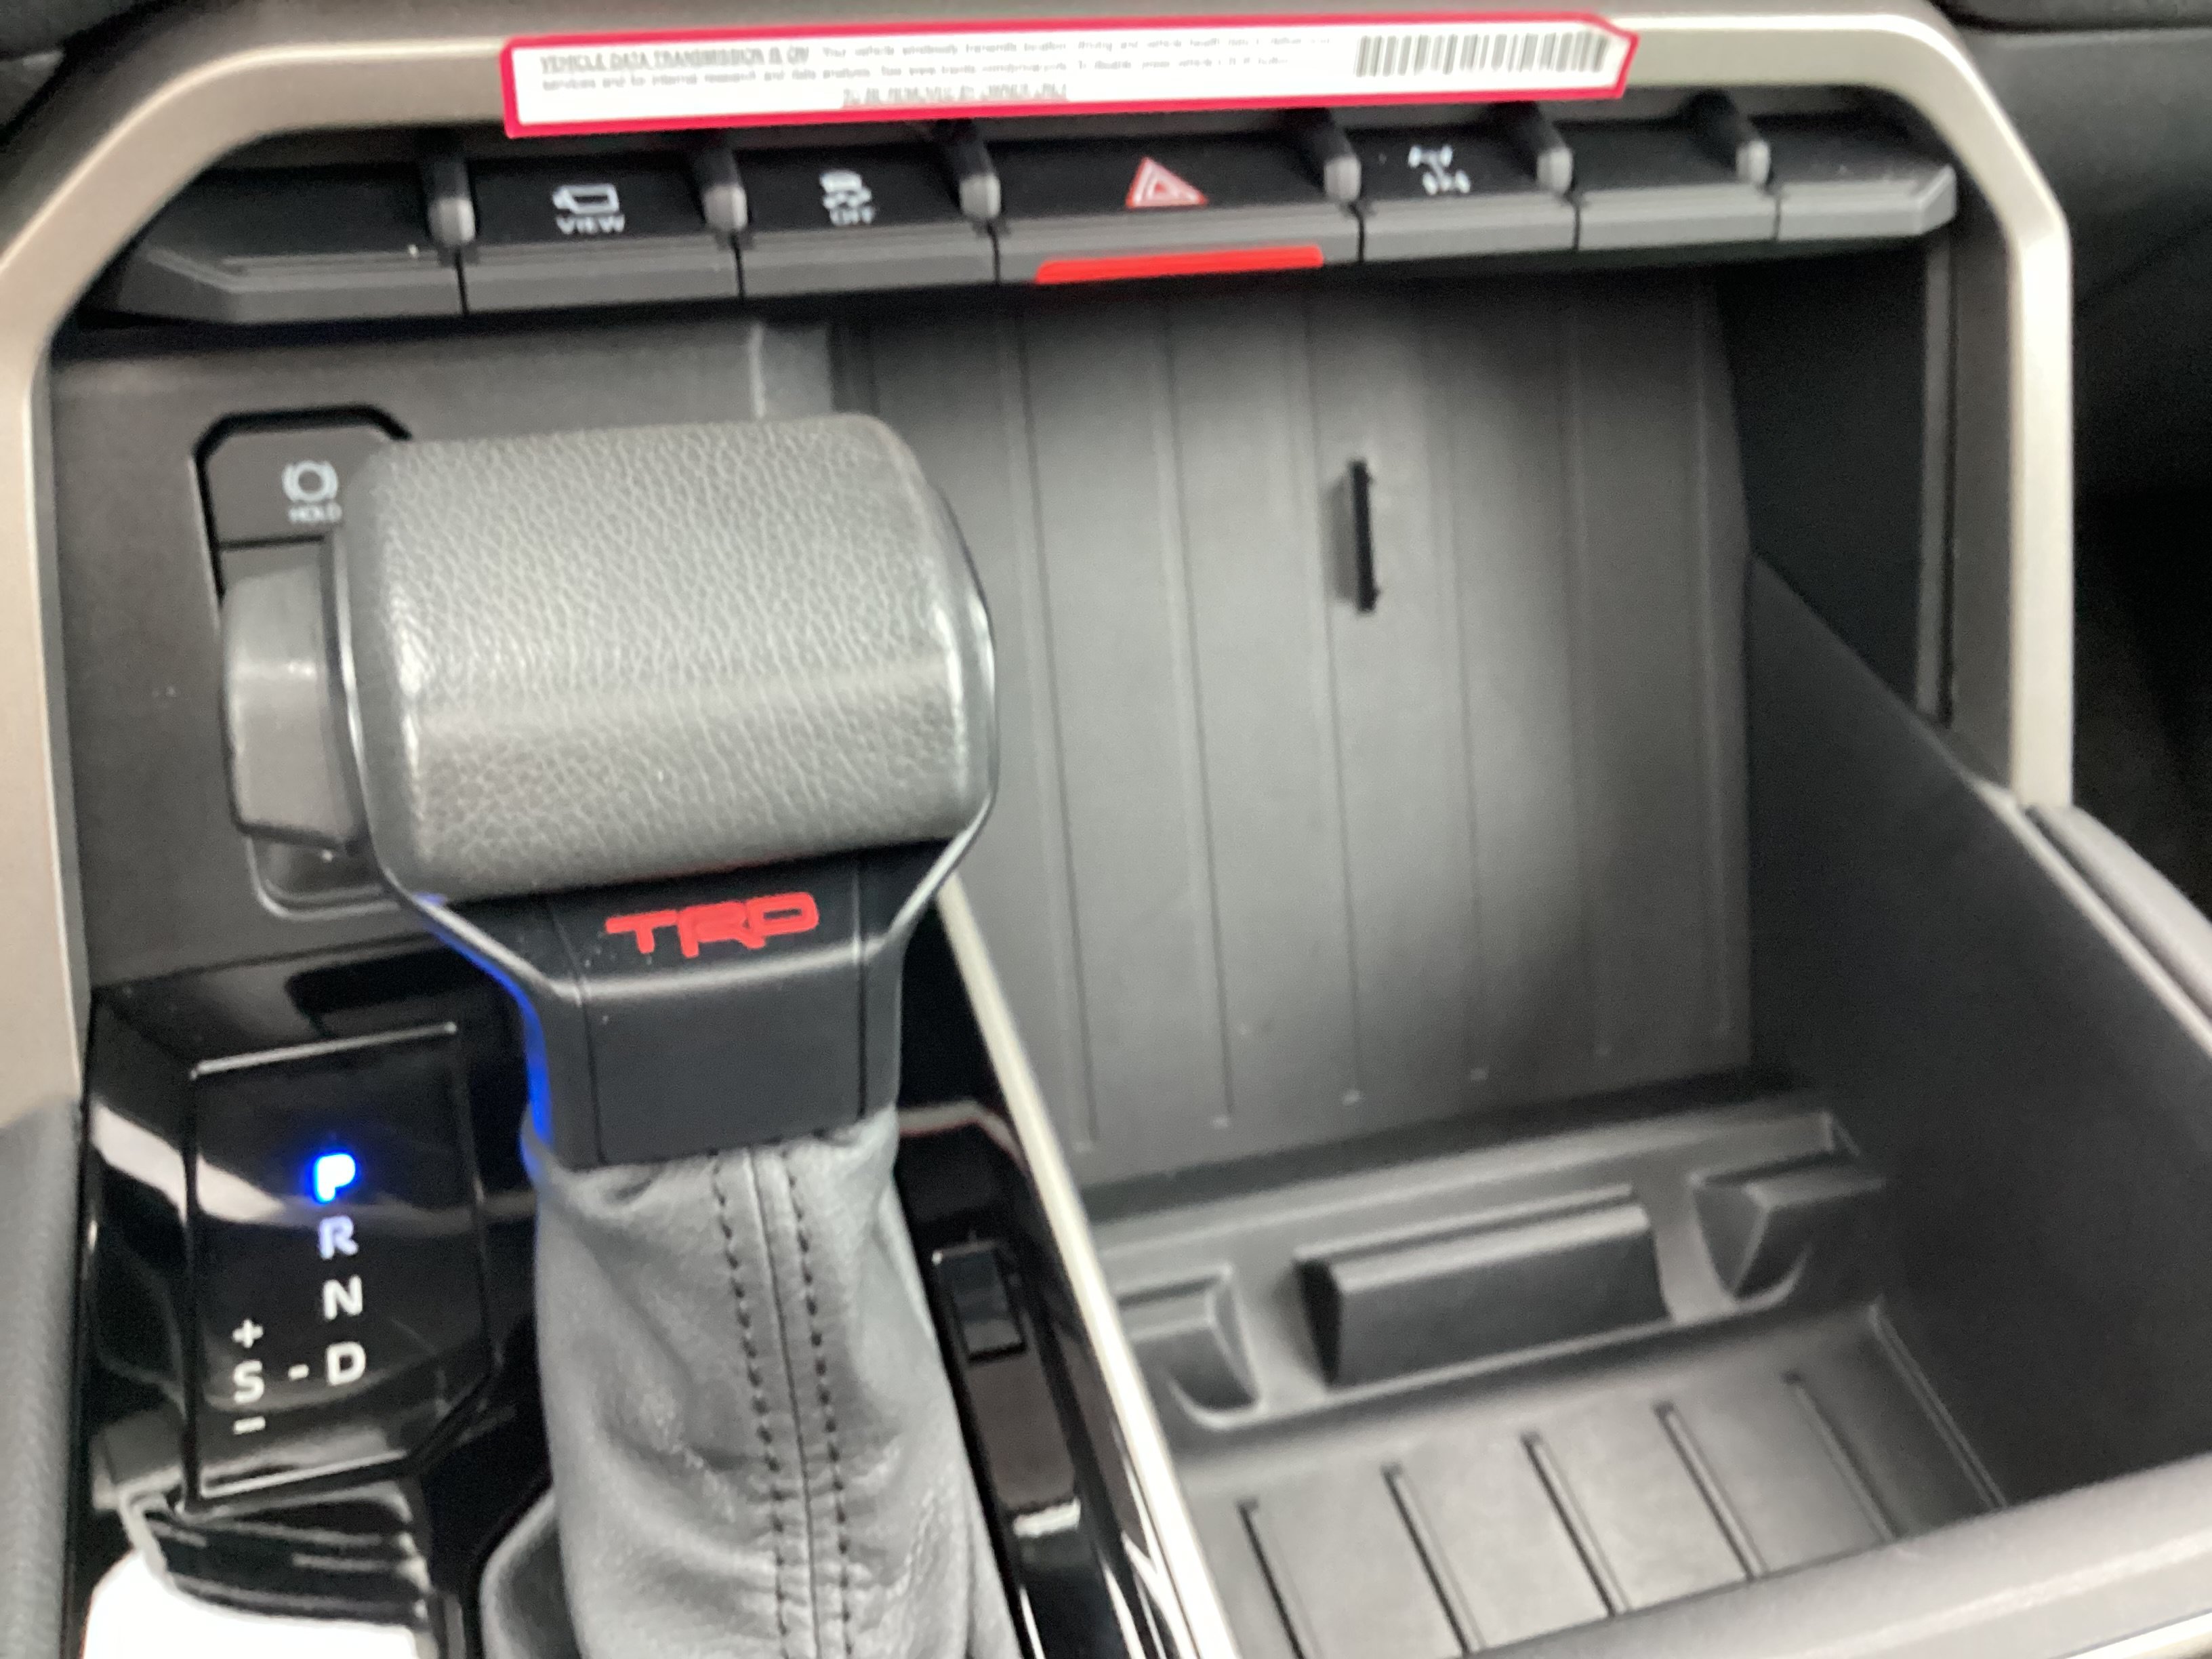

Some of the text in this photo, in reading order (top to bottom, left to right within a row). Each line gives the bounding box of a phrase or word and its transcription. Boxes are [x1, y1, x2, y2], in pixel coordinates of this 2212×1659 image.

[556, 213, 626, 235] VIEW
[604, 890, 820, 959] TRD
[313, 1152, 356, 1204] P
[319, 1215, 359, 1260] R
[322, 1274, 364, 1321] N
[232, 1359, 266, 1404] S
[325, 1340, 367, 1387] D
